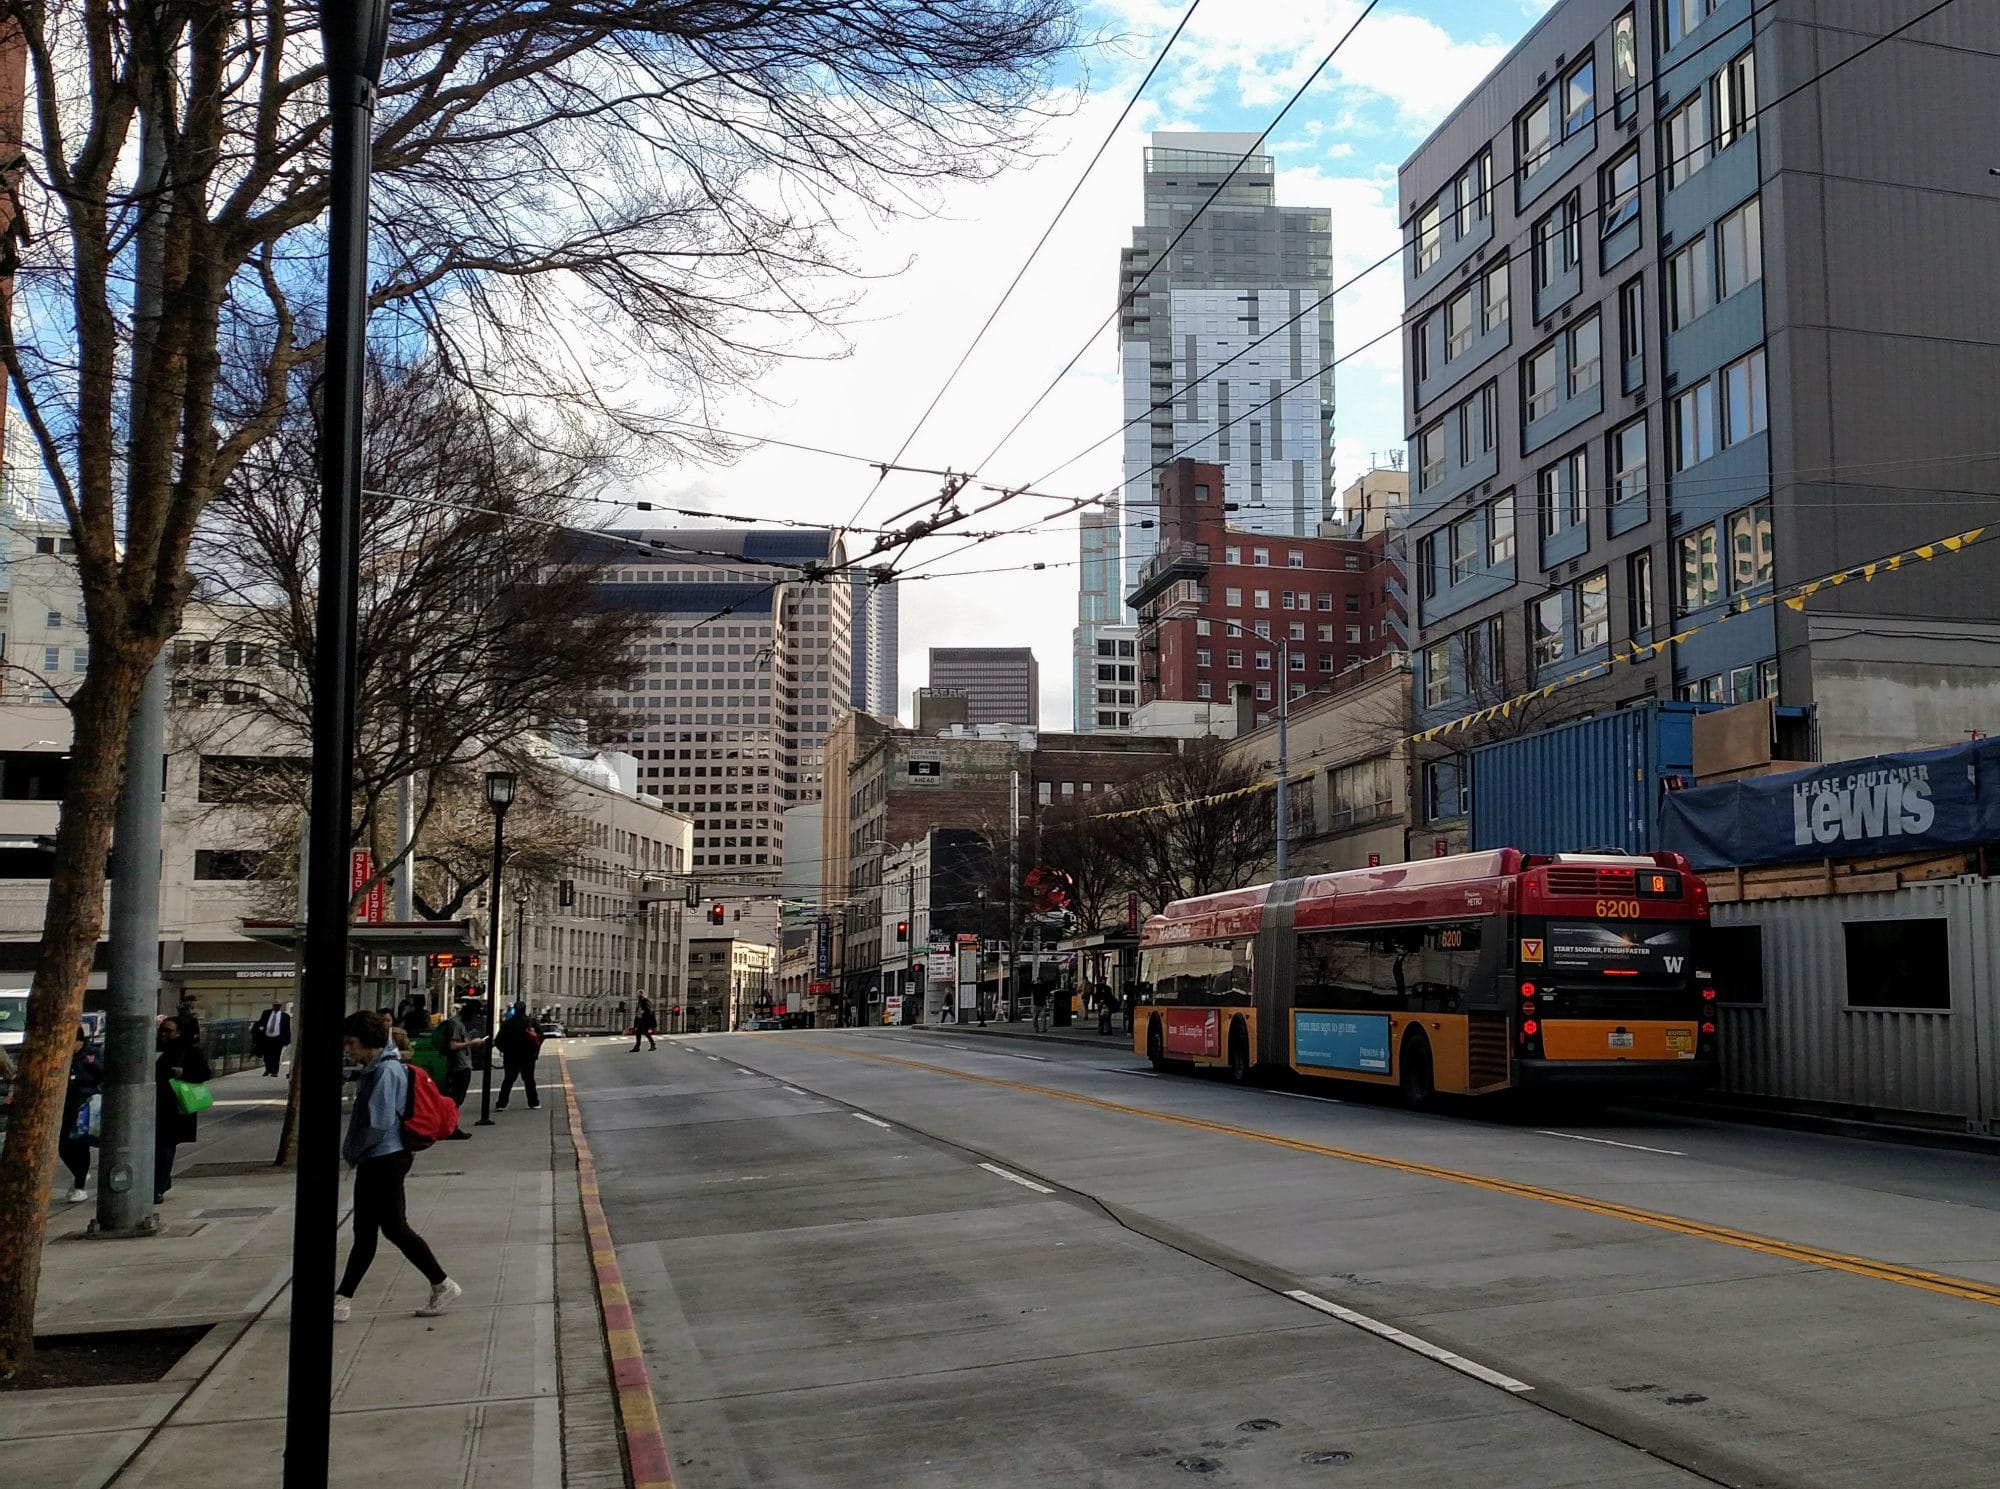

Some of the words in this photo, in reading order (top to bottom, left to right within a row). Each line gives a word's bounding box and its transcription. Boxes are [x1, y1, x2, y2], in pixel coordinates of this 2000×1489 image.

[1793, 777, 1840, 797] LEASE
[1846, 764, 1929, 791] CRUTCHER
[1596, 899, 1640, 918] 6200
[1441, 930, 1461, 947] 6200
[1574, 946, 1603, 954] SOONER,
[1663, 956, 1684, 973] W
